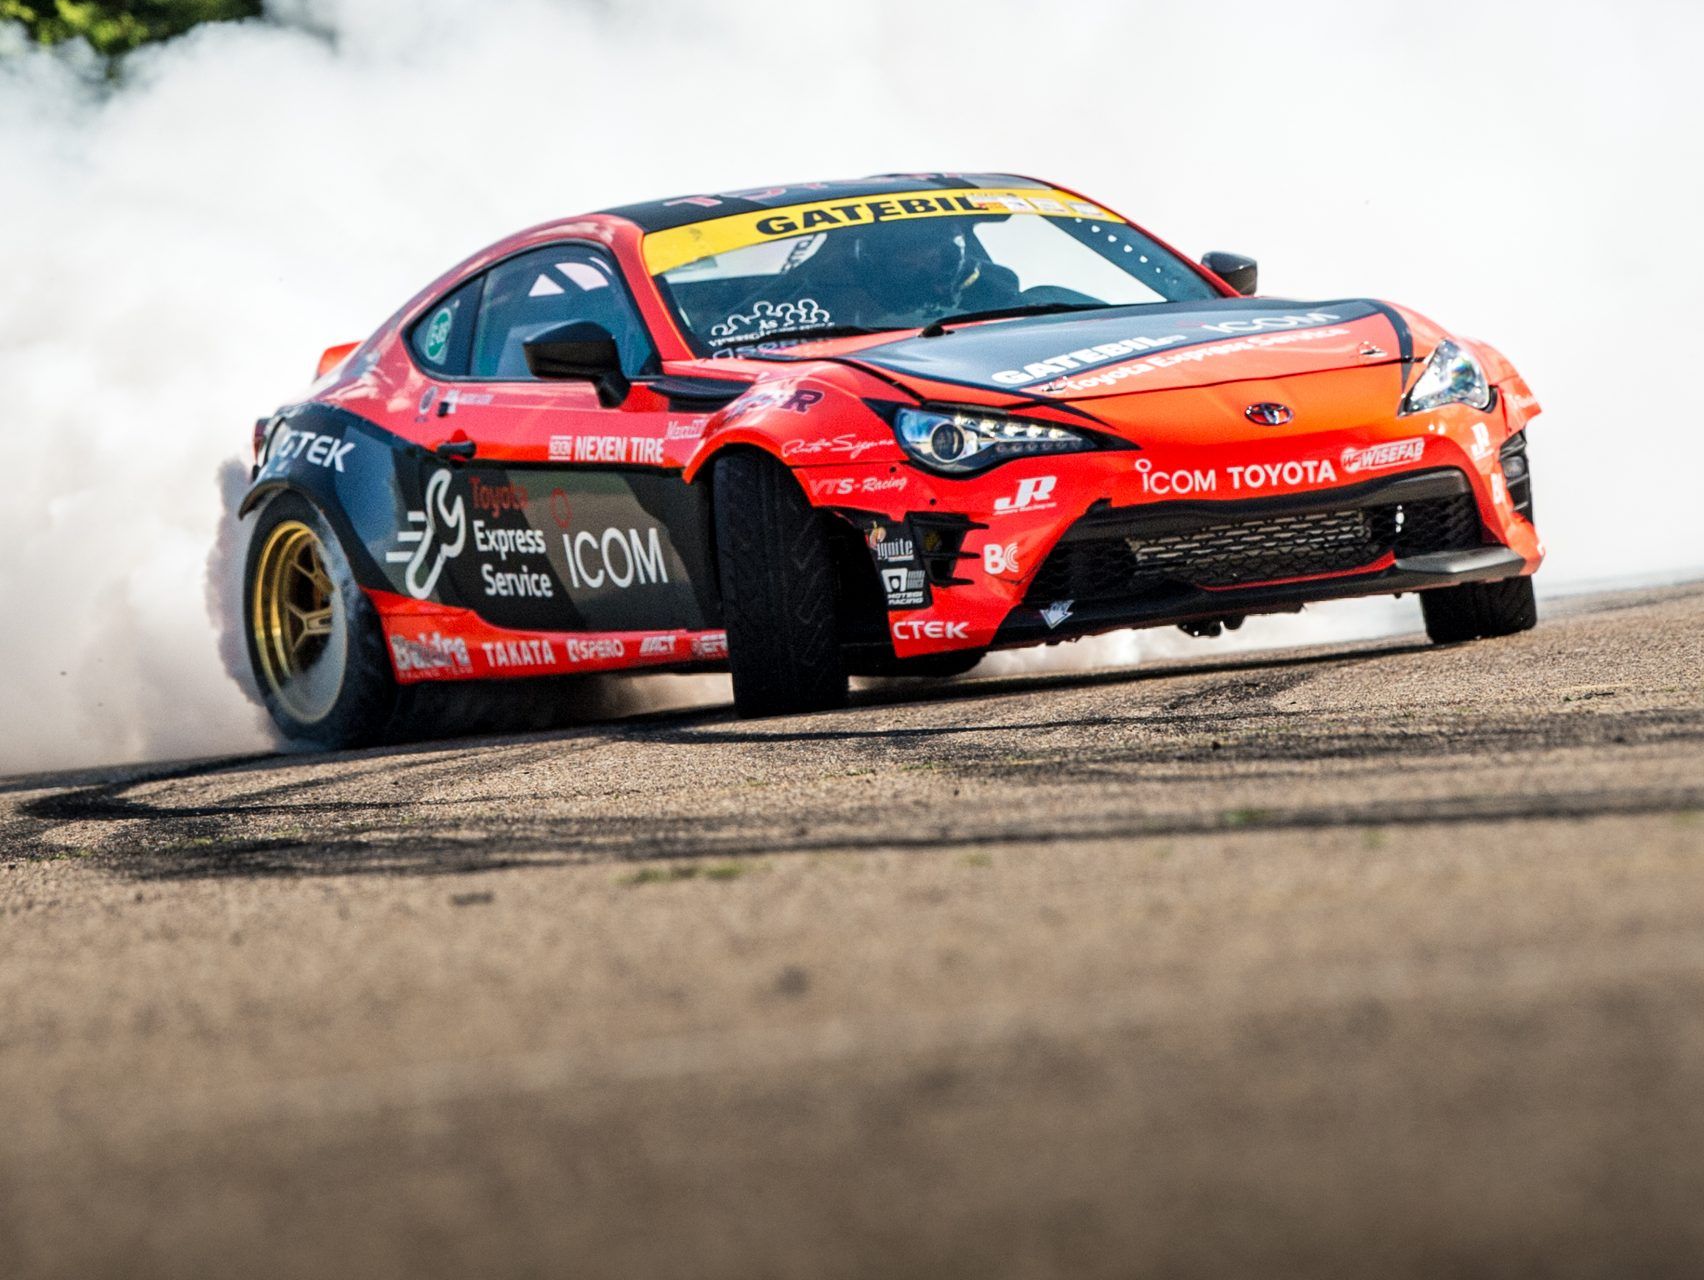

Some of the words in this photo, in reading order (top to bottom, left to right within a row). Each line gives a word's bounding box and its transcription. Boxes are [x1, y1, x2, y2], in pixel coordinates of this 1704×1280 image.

[756, 193, 988, 235] GATEBIL
[991, 336, 1168, 384] GATEBIL
[1067, 361, 1155, 391] Toyota
[1145, 341, 1255, 368] Express
[574, 435, 627, 462] NEXEN
[629, 436, 665, 464] TIRE
[1359, 439, 1424, 467] WISEFAB
[1226, 459, 1337, 490] TOYOTA
[468, 476, 529, 518] Toyota
[473, 520, 546, 561] Express
[481, 563, 554, 598] Service
[893, 620, 969, 640] CTEK
[481, 640, 556, 669] TAKATA
